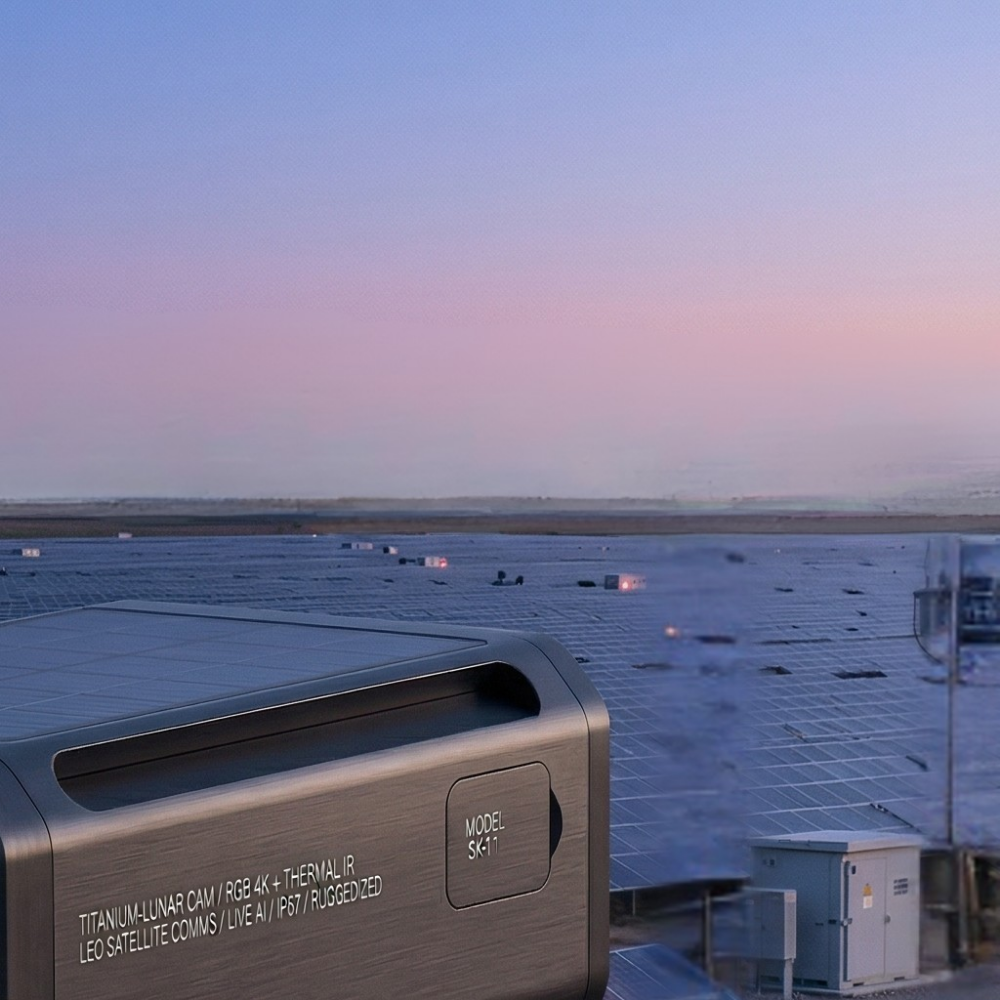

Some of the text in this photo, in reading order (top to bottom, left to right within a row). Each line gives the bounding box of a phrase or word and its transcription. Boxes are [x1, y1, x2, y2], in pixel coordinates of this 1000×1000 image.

[466, 811, 505, 838] MODEL
[79, 893, 184, 936] TITANIUM-LUNAR
[187, 886, 214, 912] CAM
[217, 883, 223, 907] /
[226, 877, 251, 904] RGB
[254, 874, 270, 896] 4K
[271, 875, 281, 892] +
[343, 854, 355, 876] IR
[80, 939, 104, 964] LEO
[106, 923, 169, 958] SATELLITE
[171, 912, 217, 943] COMMS
[219, 910, 225, 934] /
[228, 903, 252, 930] LIVE
[255, 900, 267, 923] AI
[268, 898, 274, 923] /
[303, 891, 309, 914] /
